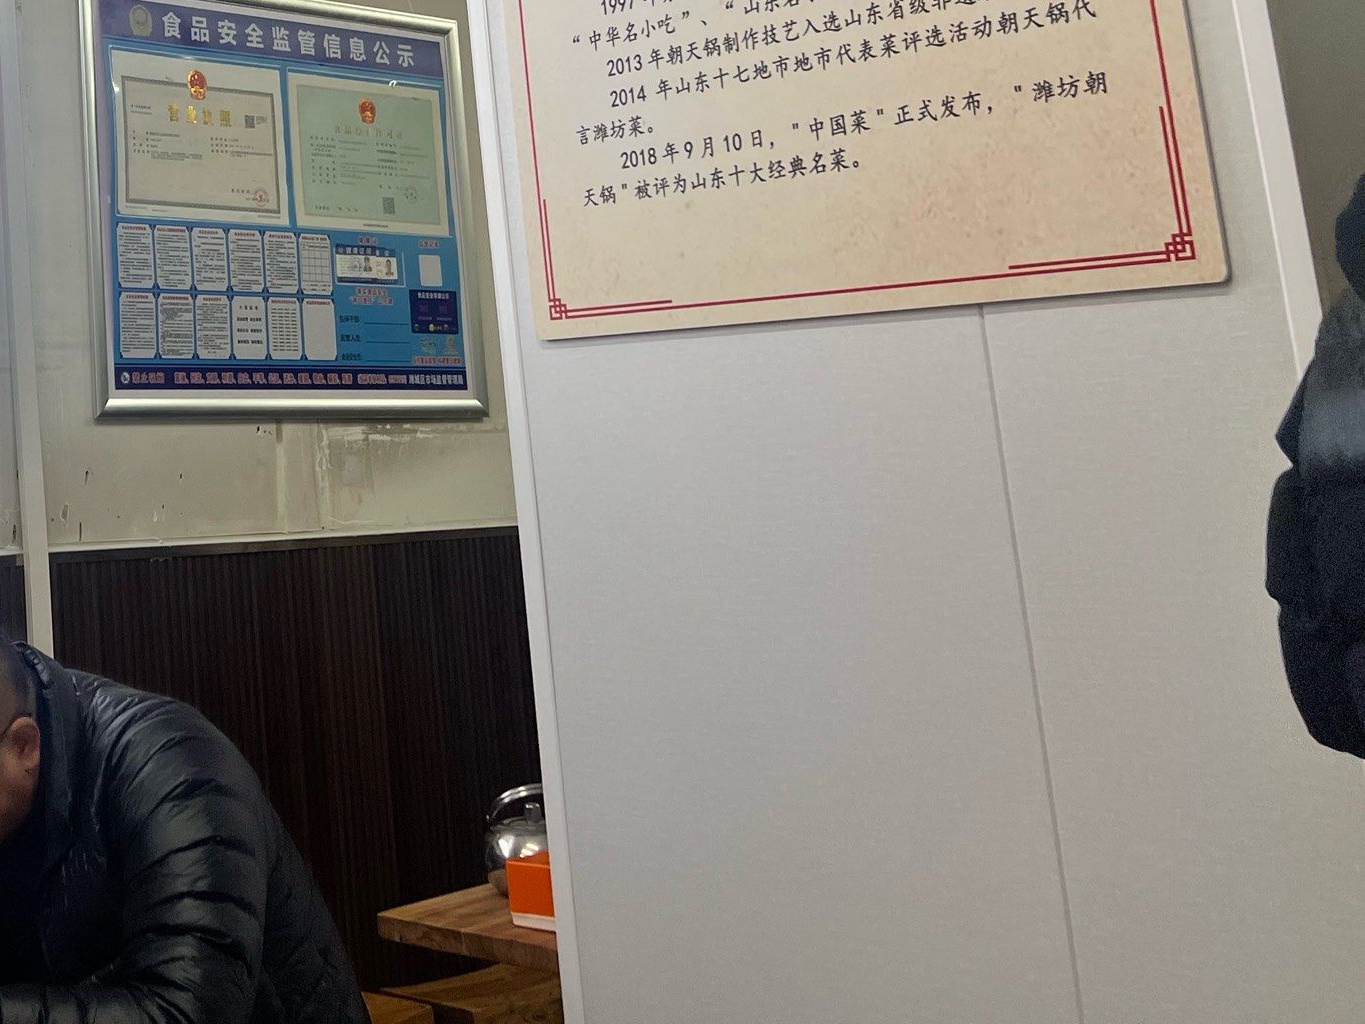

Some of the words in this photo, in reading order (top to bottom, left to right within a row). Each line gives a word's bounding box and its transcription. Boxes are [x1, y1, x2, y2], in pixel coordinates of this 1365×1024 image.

[161, 11, 416, 67] 食品安全监管信息公示
